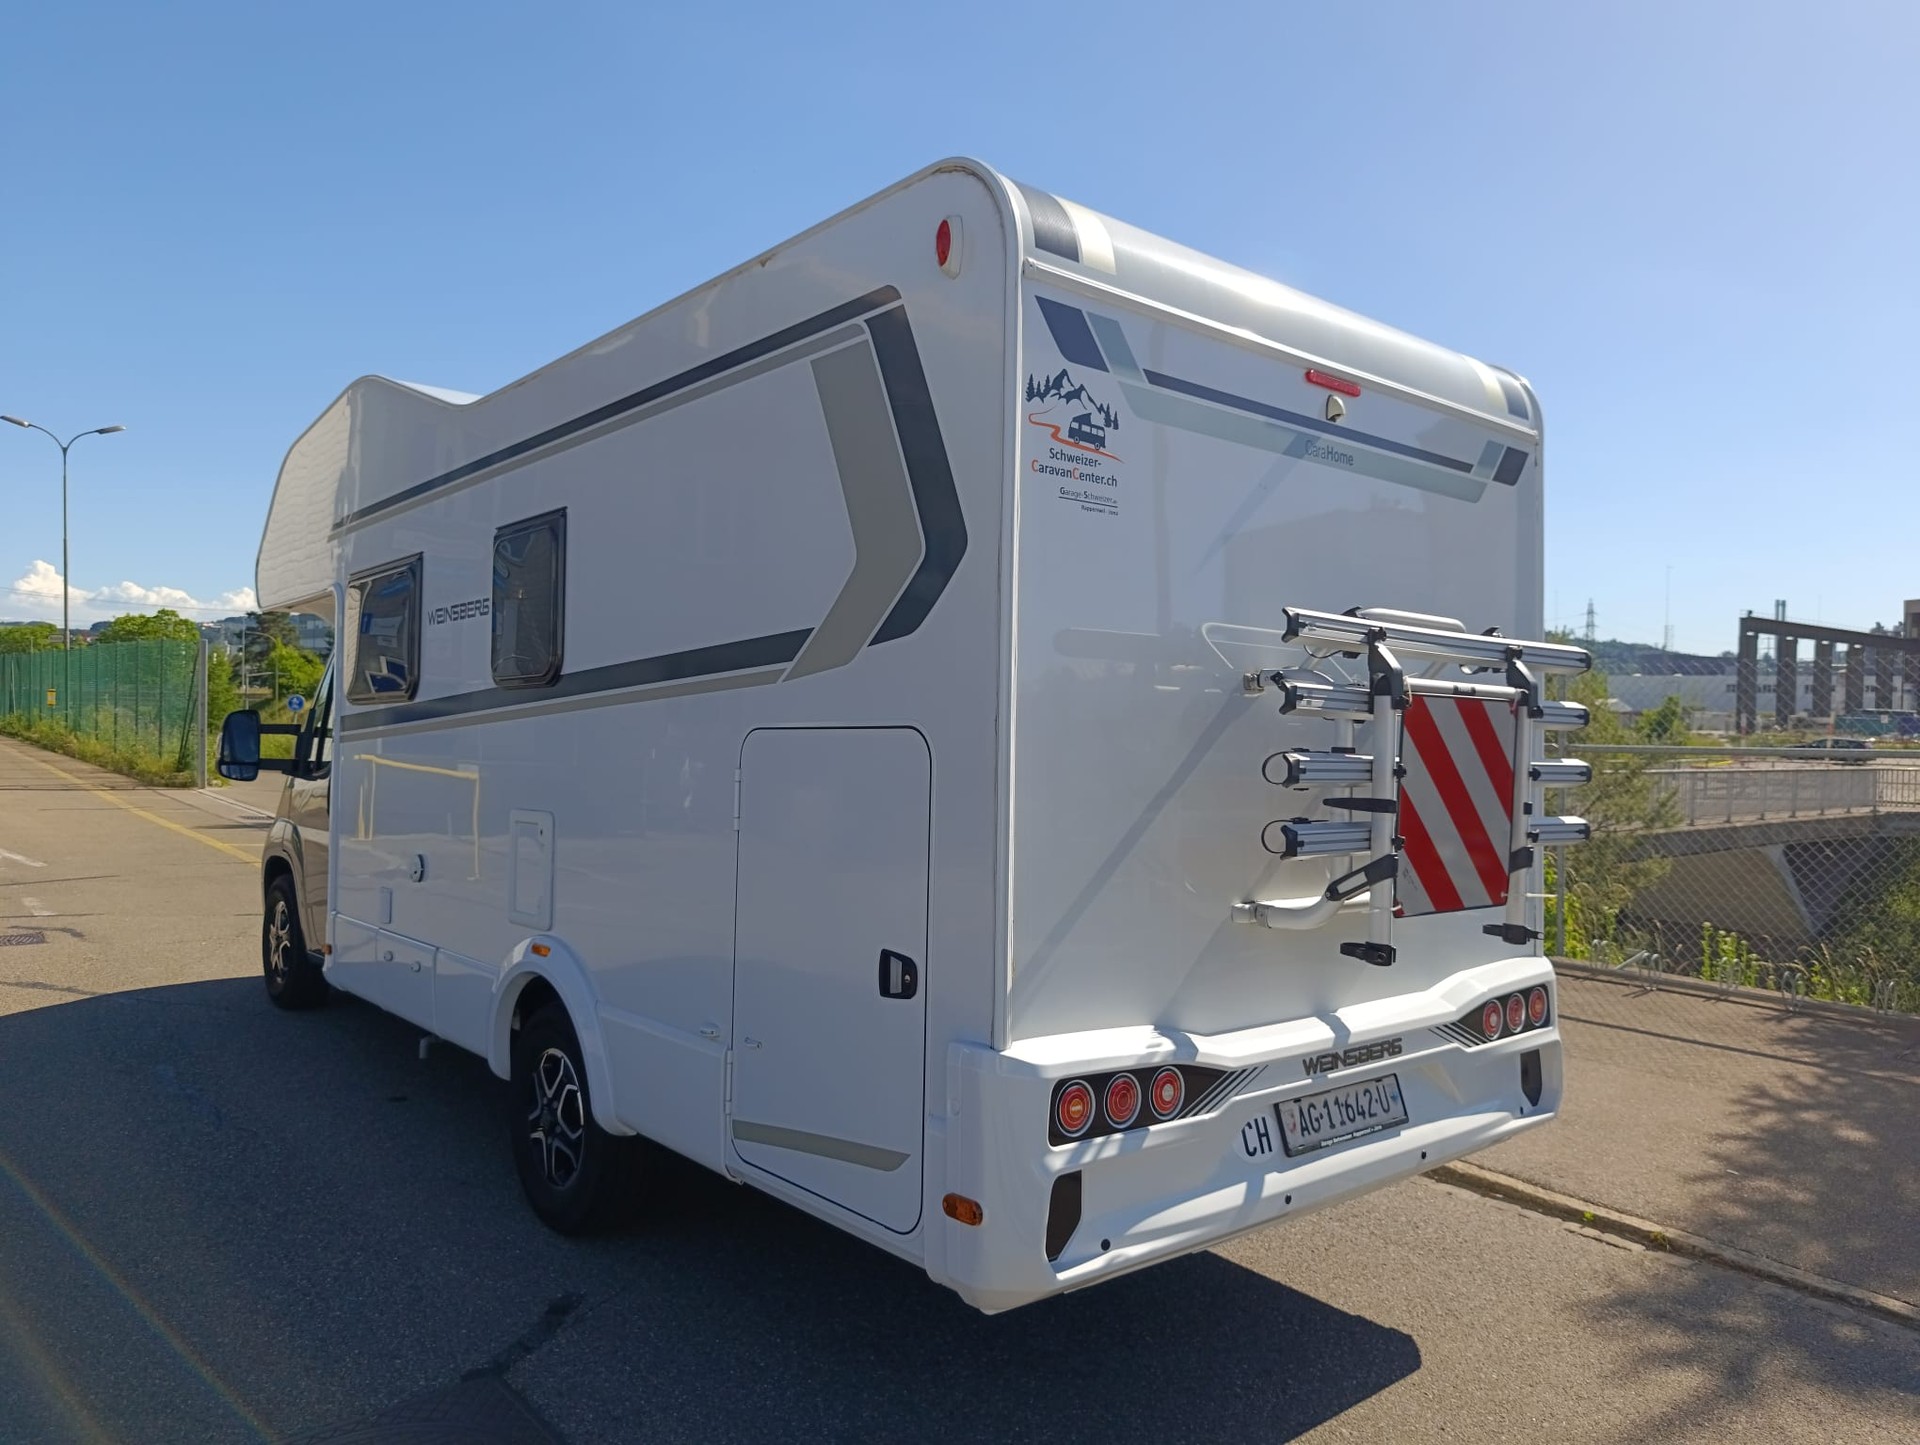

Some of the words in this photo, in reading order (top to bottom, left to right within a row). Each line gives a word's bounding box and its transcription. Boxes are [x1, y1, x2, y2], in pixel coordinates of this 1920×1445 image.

[1049, 447, 1101, 468] Schweizer-
[1305, 440, 1354, 466] CaraHome
[1031, 459, 1118, 488] CaravanCenter.ch
[428, 598, 490, 626] WEINSBERG
[1302, 1037, 1403, 1076] WEINSBERG
[1241, 1116, 1273, 1157] CH
